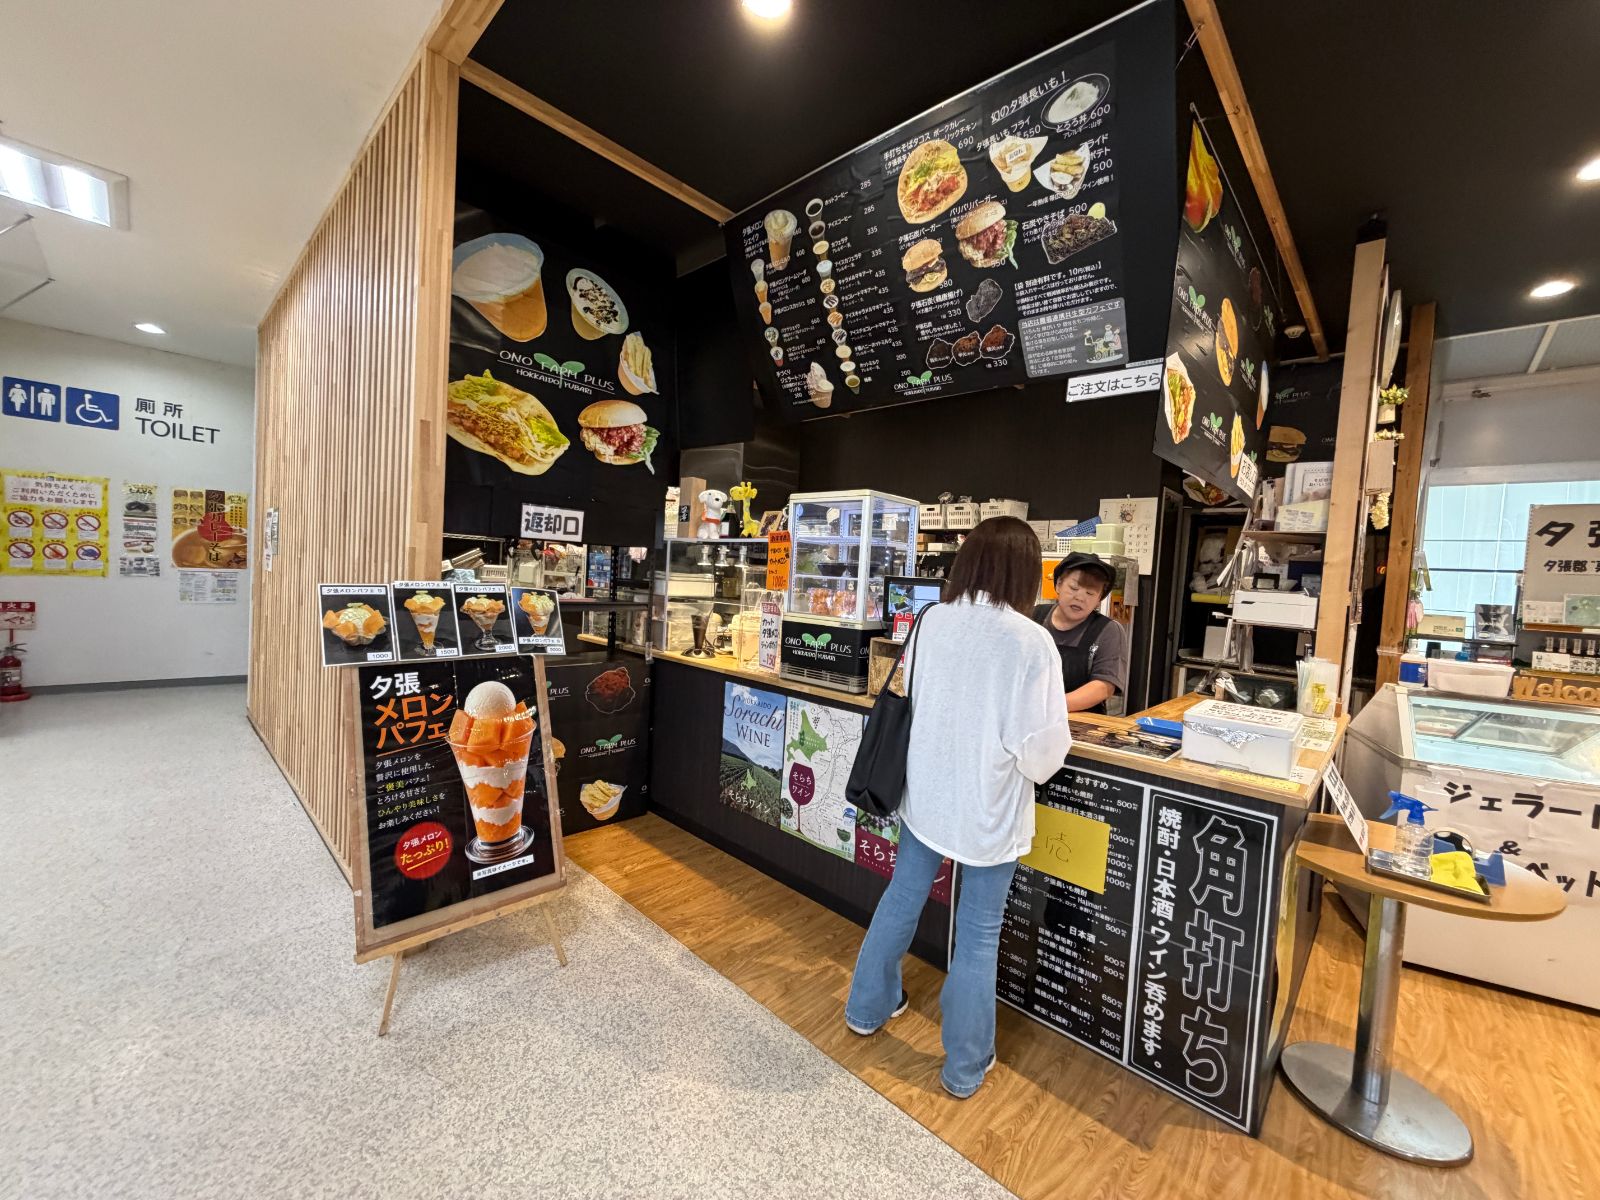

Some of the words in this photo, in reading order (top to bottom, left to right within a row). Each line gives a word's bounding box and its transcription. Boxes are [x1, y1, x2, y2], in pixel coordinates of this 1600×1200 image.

[1090, 103, 1111, 119] 600
[1010, 115, 1031, 133] フライ
[1023, 125, 1041, 139] 550
[958, 136, 974, 149] 690
[1093, 158, 1113, 173] 500
[825, 191, 848, 206] ホットコーヒー
[1068, 202, 1088, 213] 500
[828, 215, 852, 229] アイスコーヒー
[864, 204, 875, 215] 285
[866, 226, 878, 235] 335
[875, 269, 886, 278] 435
[879, 286, 889, 294] 435
[947, 308, 962, 318] 330
[499, 350, 533, 366] ONO
[541, 360, 578, 380] FARM
[584, 374, 615, 391] PLUS
[993, 358, 1008, 367] 330
[516, 368, 560, 385] HOKKAIDO
[564, 380, 593, 395] YUBARI
[893, 382, 909, 390] ONO
[933, 373, 953, 383] PLUS
[1068, 371, 1161, 397] ご注文はこちら
[135, 416, 221, 444] TOILET
[12, 487, 96, 499] ご利用いただくために
[524, 511, 580, 536] 返却口
[785, 636, 801, 646] ONO
[805, 640, 827, 650] FARM
[830, 643, 852, 654] PLUS
[792, 649, 816, 658] HOKKAIDO
[369, 671, 421, 700] 夕張
[550, 686, 569, 695] PLUS
[373, 693, 453, 727] メロン
[725, 694, 786, 732] Sorachi
[375, 720, 450, 750] パフェ
[735, 722, 771, 748] WINE
[580, 746, 597, 755] ONO
[620, 738, 636, 746] PLUS
[376, 753, 422, 771] 夕張メロンを
[376, 762, 436, 782] 贅沢に使用した、
[792, 771, 812, 785] そらち
[376, 774, 431, 794] ご褒美パフェ!
[792, 785, 811, 798] ワイン
[1048, 782, 1094, 800] 夕張長いも焼酎
[1075, 775, 1109, 790] おすすめ
[377, 786, 428, 805] とろける甘さと
[377, 792, 447, 818] ひんやり美味しさを
[728, 789, 771, 814] そらちワイン
[378, 805, 441, 830] お楽しみください!
[402, 830, 443, 851] 夕張メロン
[1499, 841, 1522, 856] &
[400, 837, 450, 866] たっぷり!
[1043, 876, 1088, 896] 夕張長いも焼酎
[1077, 894, 1102, 911] Hajimari
[1069, 925, 1097, 944] 日本酒
[1140, 805, 1183, 1069] 焼酎・日本酒・ワイン呑めます。
[1037, 948, 1103, 983] 新十津川(新十津川町)
[1180, 815, 1248, 1097] 角打ち
